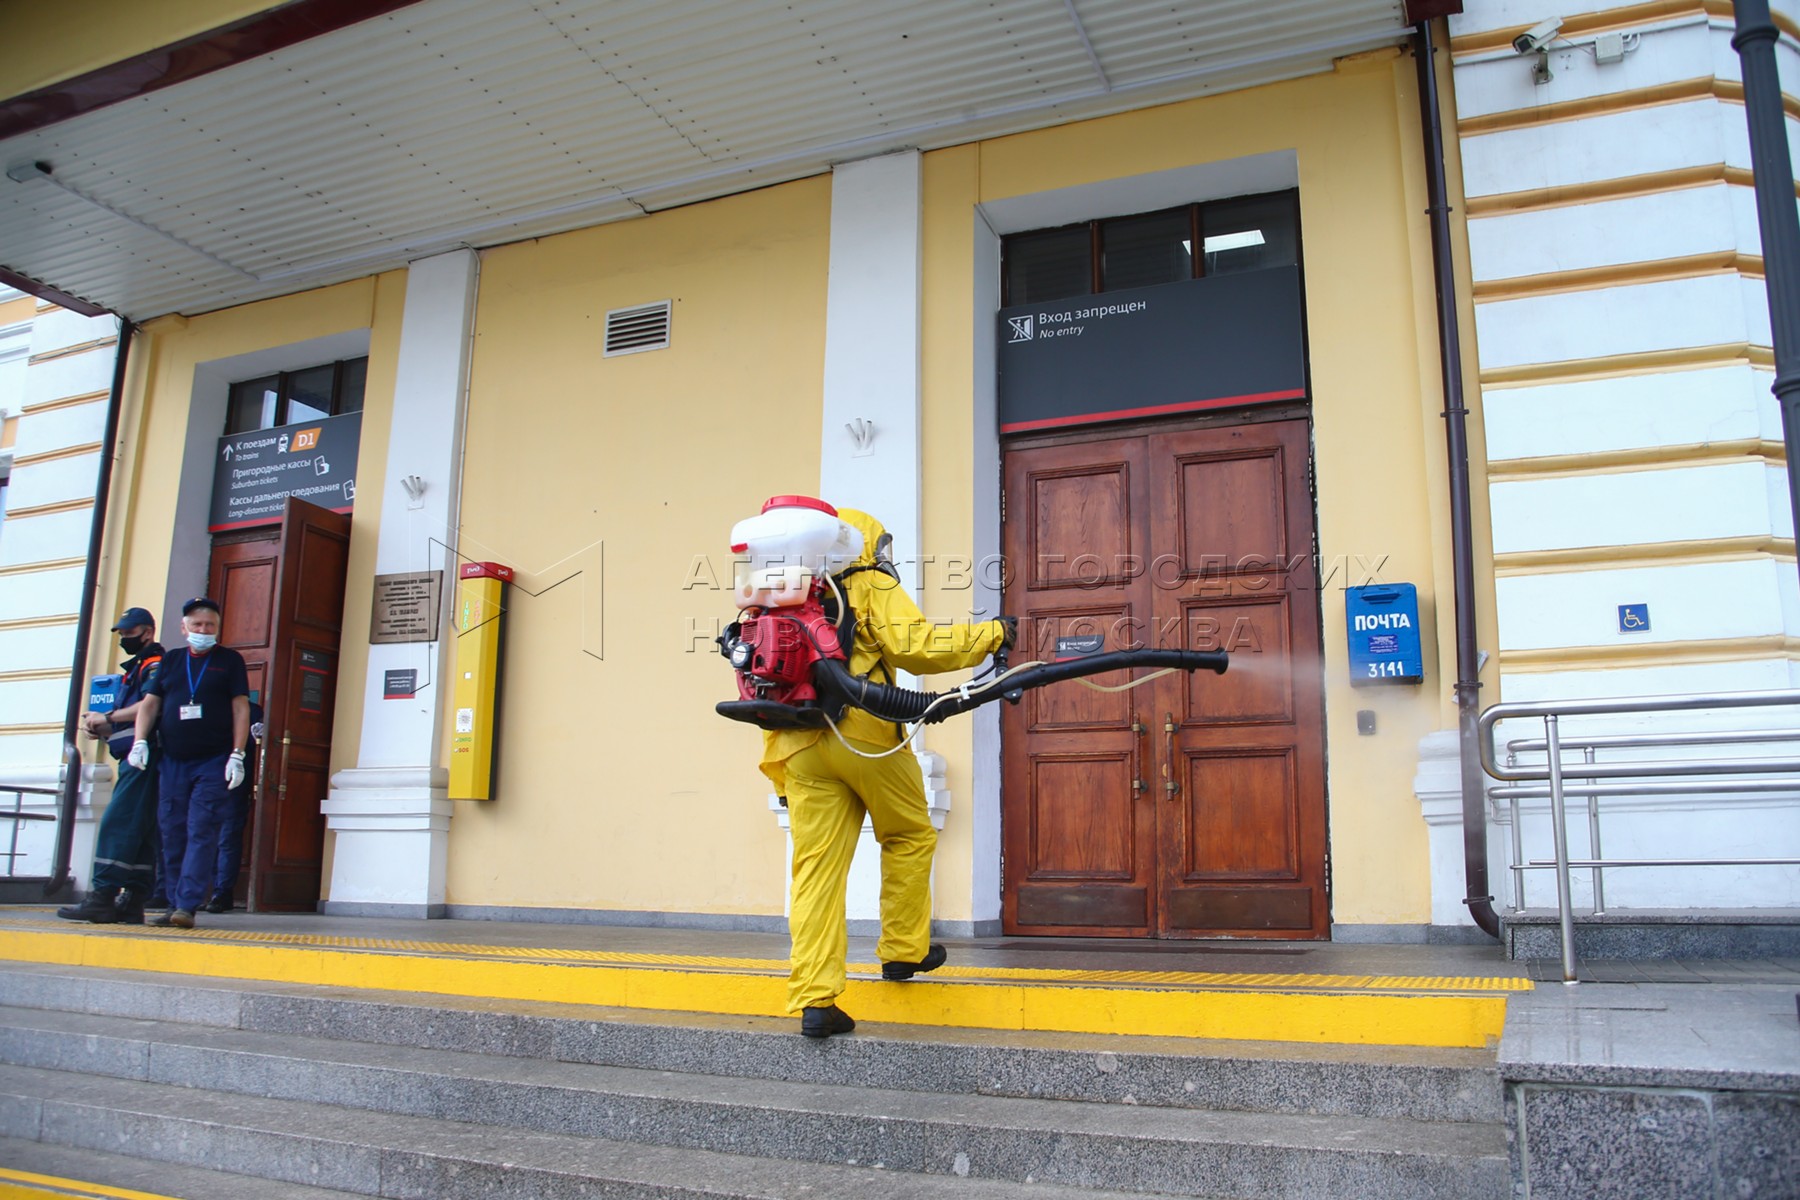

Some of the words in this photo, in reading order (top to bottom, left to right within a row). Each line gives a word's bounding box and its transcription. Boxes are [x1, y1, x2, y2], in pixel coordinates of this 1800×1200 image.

[1039, 312, 1072, 325] Вход
[1075, 301, 1146, 319] запрещен
[1039, 329, 1054, 339] No
[1056, 326, 1085, 338] entry
[236, 442, 243, 451] К
[243, 437, 277, 449] поездам
[298, 433, 314, 447] D1
[242, 452, 259, 461] trains
[232, 463, 287, 479] Пригородные
[287, 459, 312, 470] кассы
[231, 480, 259, 489] Suburban
[259, 476, 279, 486] tickets
[229, 496, 253, 507] Кассы
[253, 490, 290, 504] дальнего
[291, 483, 340, 496] следования
[228, 506, 269, 518] Long-distance
[269, 503, 286, 511] ticket
[1354, 613, 1411, 631] ПОЧТА
[1368, 661, 1404, 678] 3141
[90, 693, 115, 705] ПОЧТА
